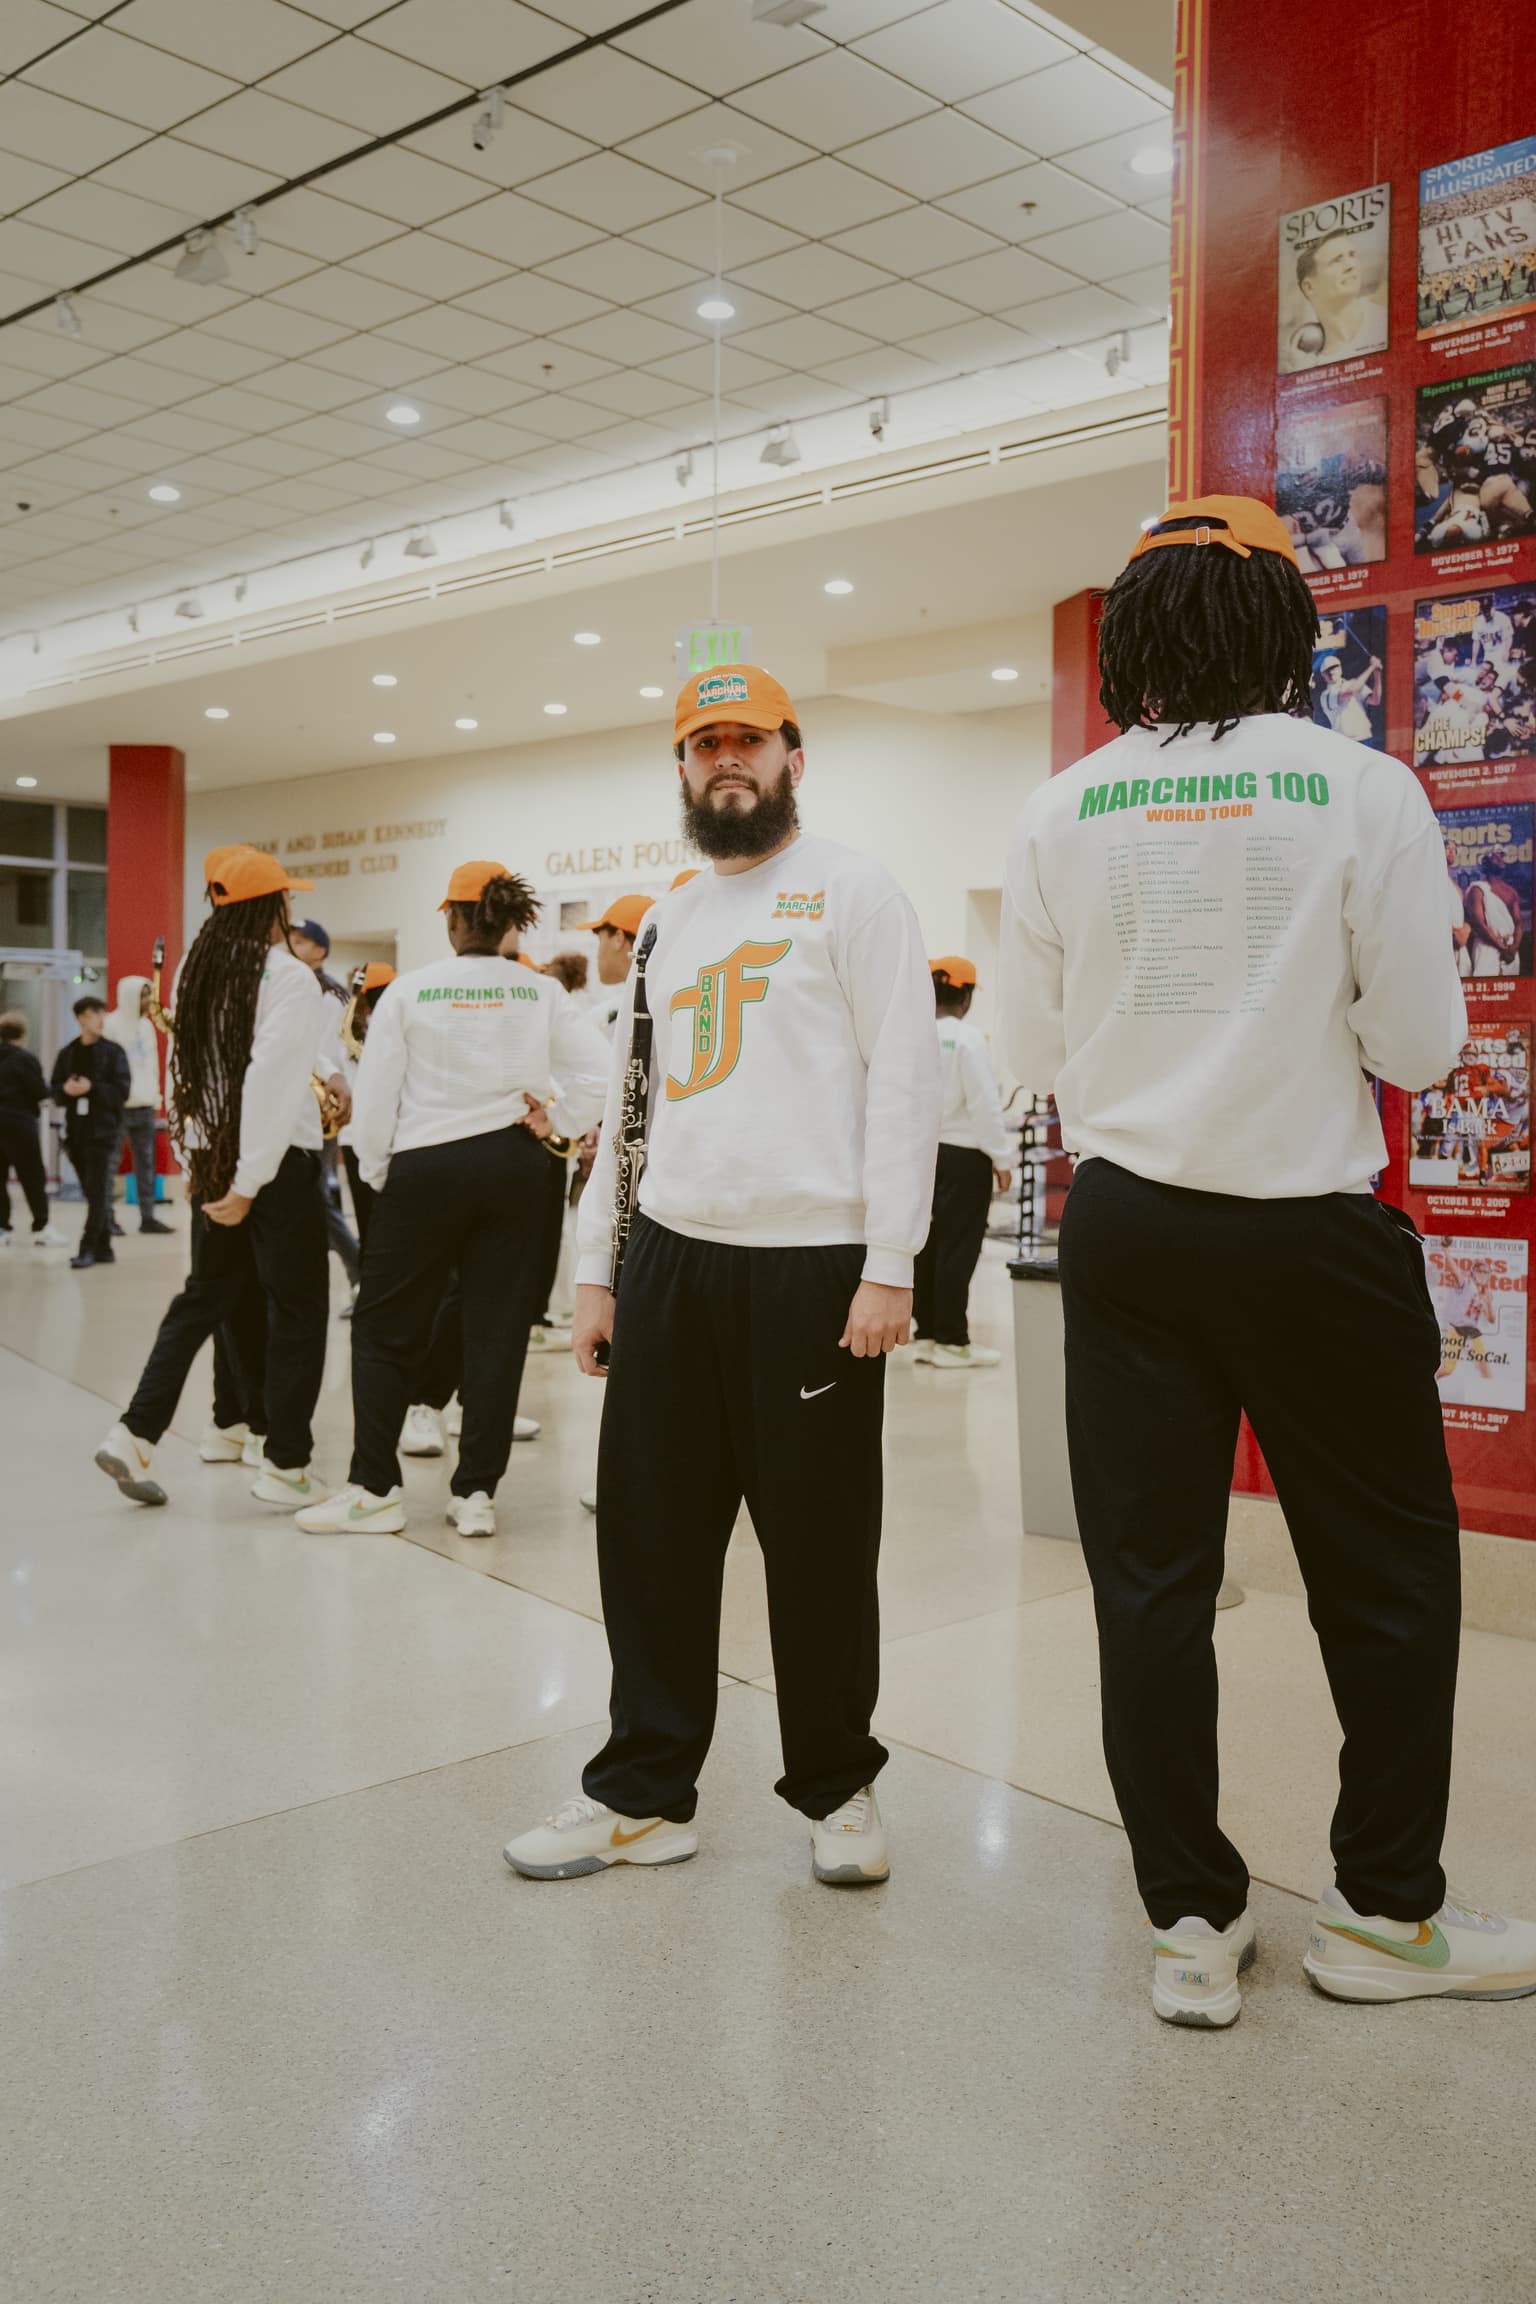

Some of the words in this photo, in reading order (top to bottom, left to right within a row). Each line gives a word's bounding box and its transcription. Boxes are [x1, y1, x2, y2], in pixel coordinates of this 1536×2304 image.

[1425, 154, 1536, 202] ILLUSTRATED
[1426, 150, 1495, 184] SPORTS
[1286, 189, 1384, 242] SPORTS
[1436, 222, 1463, 246] HI
[1444, 226, 1529, 264] FANS
[1431, 331, 1483, 352] NOVEMBER
[1422, 381, 1464, 397] Sports
[1467, 363, 1532, 387] Illustrated
[1431, 550, 1482, 567] NOVEMBER
[690, 631, 741, 672] EXIT
[1432, 718, 1450, 731] THE
[1415, 727, 1487, 752] CHAMPS!
[1429, 767, 1480, 781] NOVEMBER
[1078, 772, 1257, 821] MARCHING
[1266, 771, 1330, 806] 100
[1146, 808, 1206, 823] WORLD
[1210, 803, 1253, 821] TOUR
[286, 834, 317, 852] AND
[360, 853, 399, 874] CLUB
[546, 846, 623, 876] GALEN
[417, 987, 505, 1003] MARCHING
[509, 986, 539, 1002] 100
[699, 974, 713, 1053] BAND
[1430, 1097, 1510, 1119] BAMA
[1427, 1195, 1468, 1207] OCTOBER
[1487, 1198, 1510, 1207] 2005
[1441, 1337, 1469, 1348] ood.
[1467, 1350, 1510, 1365] SoCal.
